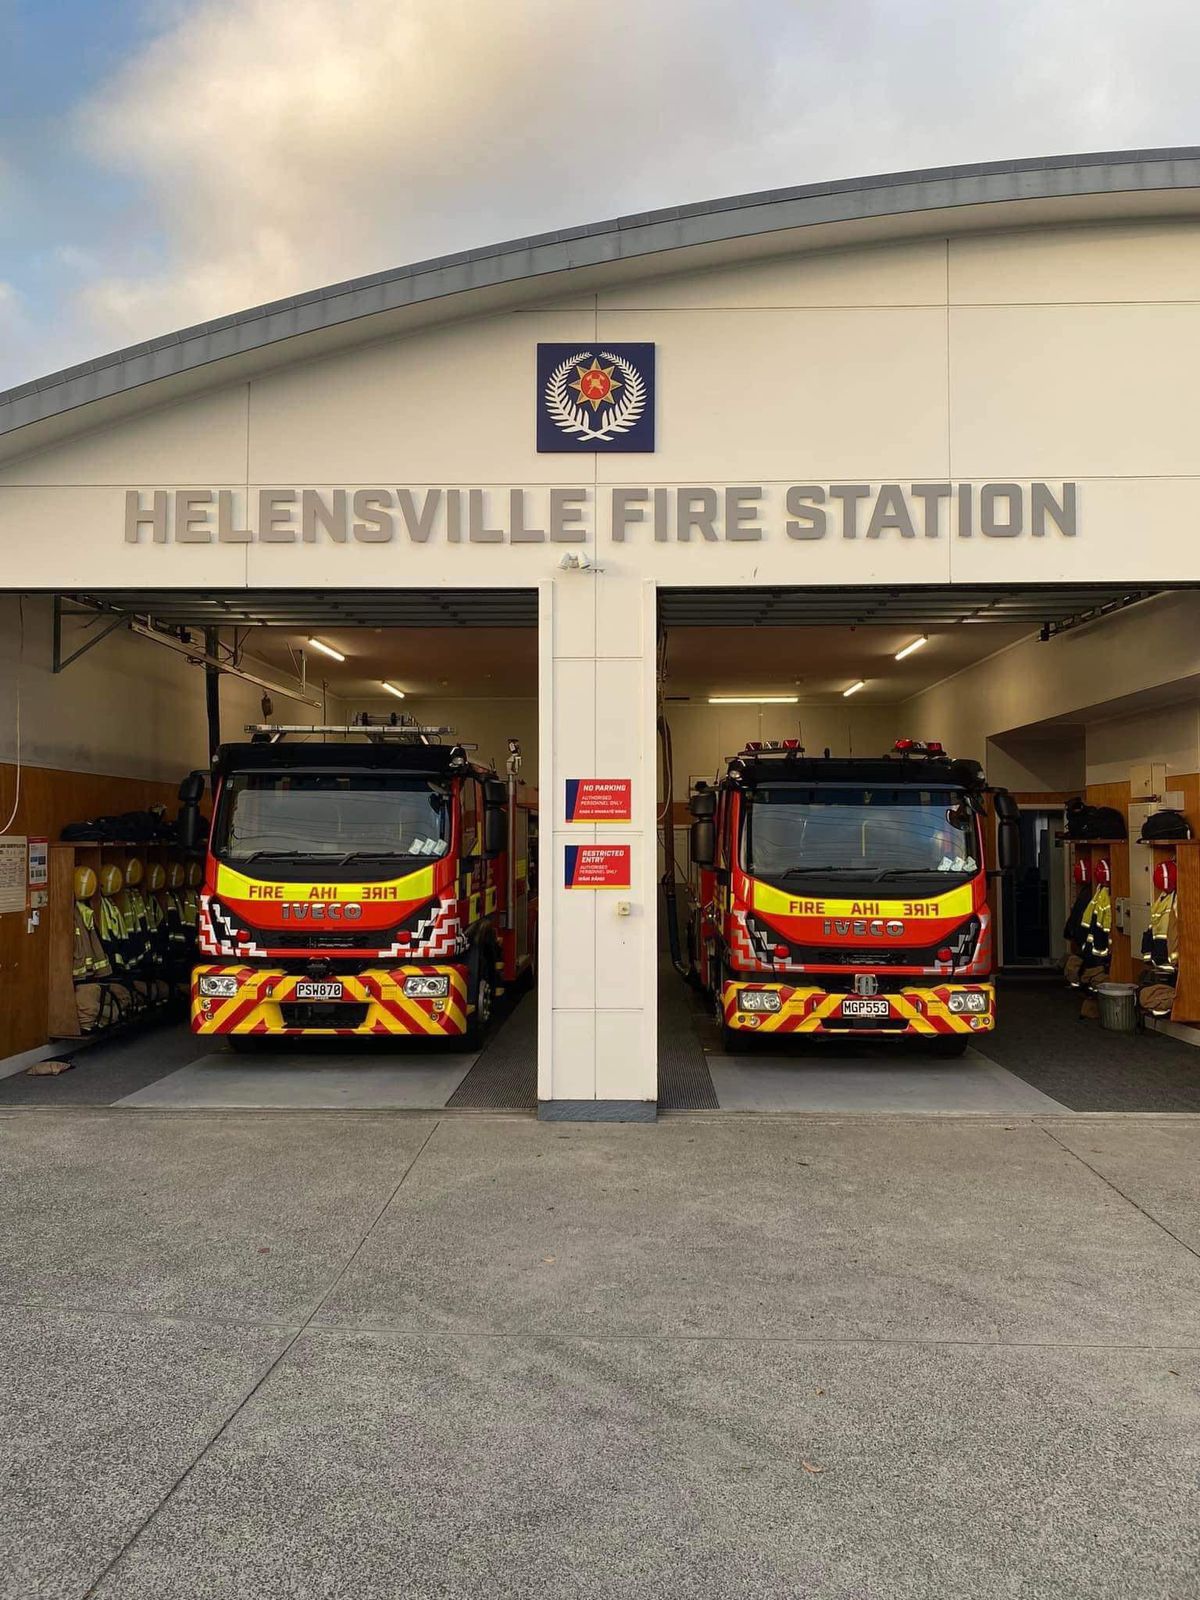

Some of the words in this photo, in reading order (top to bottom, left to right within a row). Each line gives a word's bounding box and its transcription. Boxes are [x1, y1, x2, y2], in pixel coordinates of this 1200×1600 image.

[124, 488, 587, 544] HELENSVILLE
[611, 486, 763, 543] FIRE
[786, 482, 1077, 541] STATION
[249, 886, 285, 899] FIRE
[309, 886, 337, 899] AHI
[281, 903, 362, 920] IVECO
[789, 901, 825, 914] FIRE
[851, 902, 880, 915] AHI
[823, 920, 905, 937] IVECO
[298, 984, 341, 996] PSW870
[844, 1002, 888, 1014] MGP553
